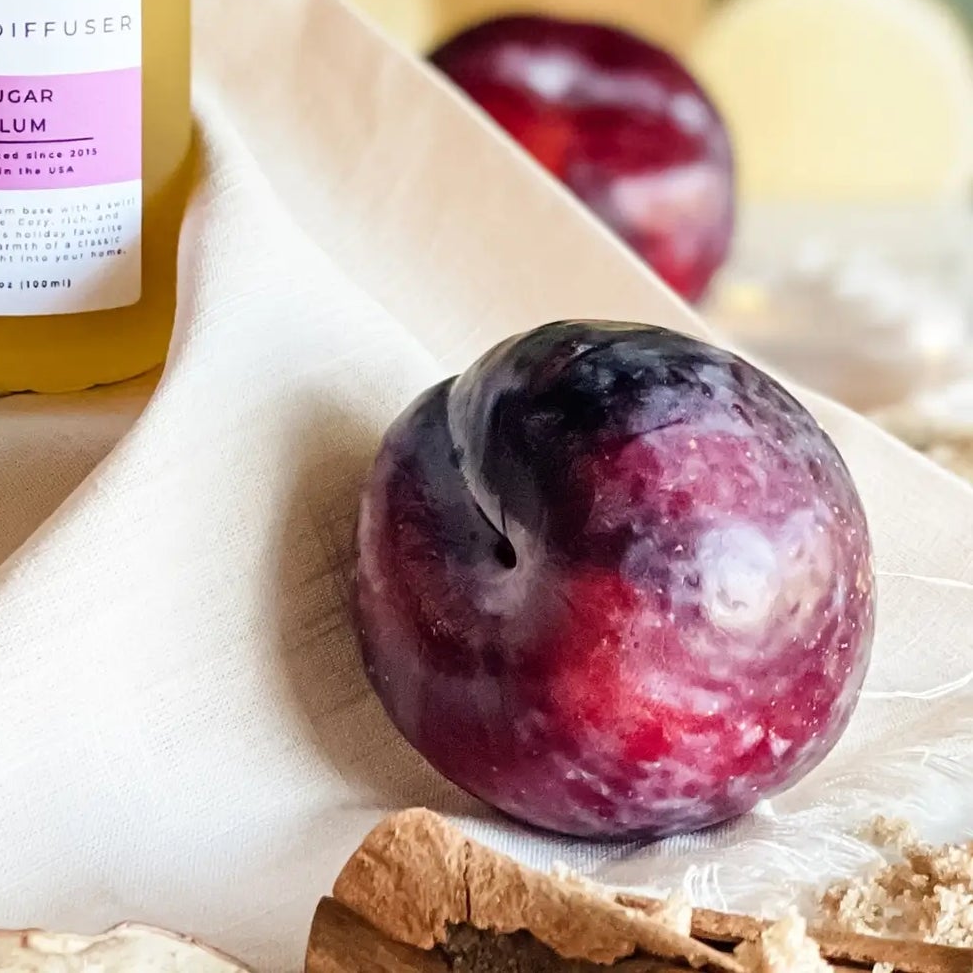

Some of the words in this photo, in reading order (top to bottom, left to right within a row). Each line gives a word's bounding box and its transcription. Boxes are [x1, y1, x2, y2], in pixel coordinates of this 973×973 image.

[27, 151, 63, 159] since
[70, 148, 98, 157] 2015
[0, 167, 11, 175] in
[19, 167, 41, 175] the
[49, 166, 74, 174] USA
[61, 203, 88, 213] with
[107, 197, 135, 209] swirl
[97, 212, 118, 221] and
[16, 230, 66, 238] holiday
[74, 225, 122, 235] favorite
[45, 241, 57, 250] of
[78, 236, 120, 247] classic
[21, 254, 48, 262] into
[55, 253, 83, 262] your
[91, 248, 126, 257] home.
[20, 279, 71, 289] (100ml)
